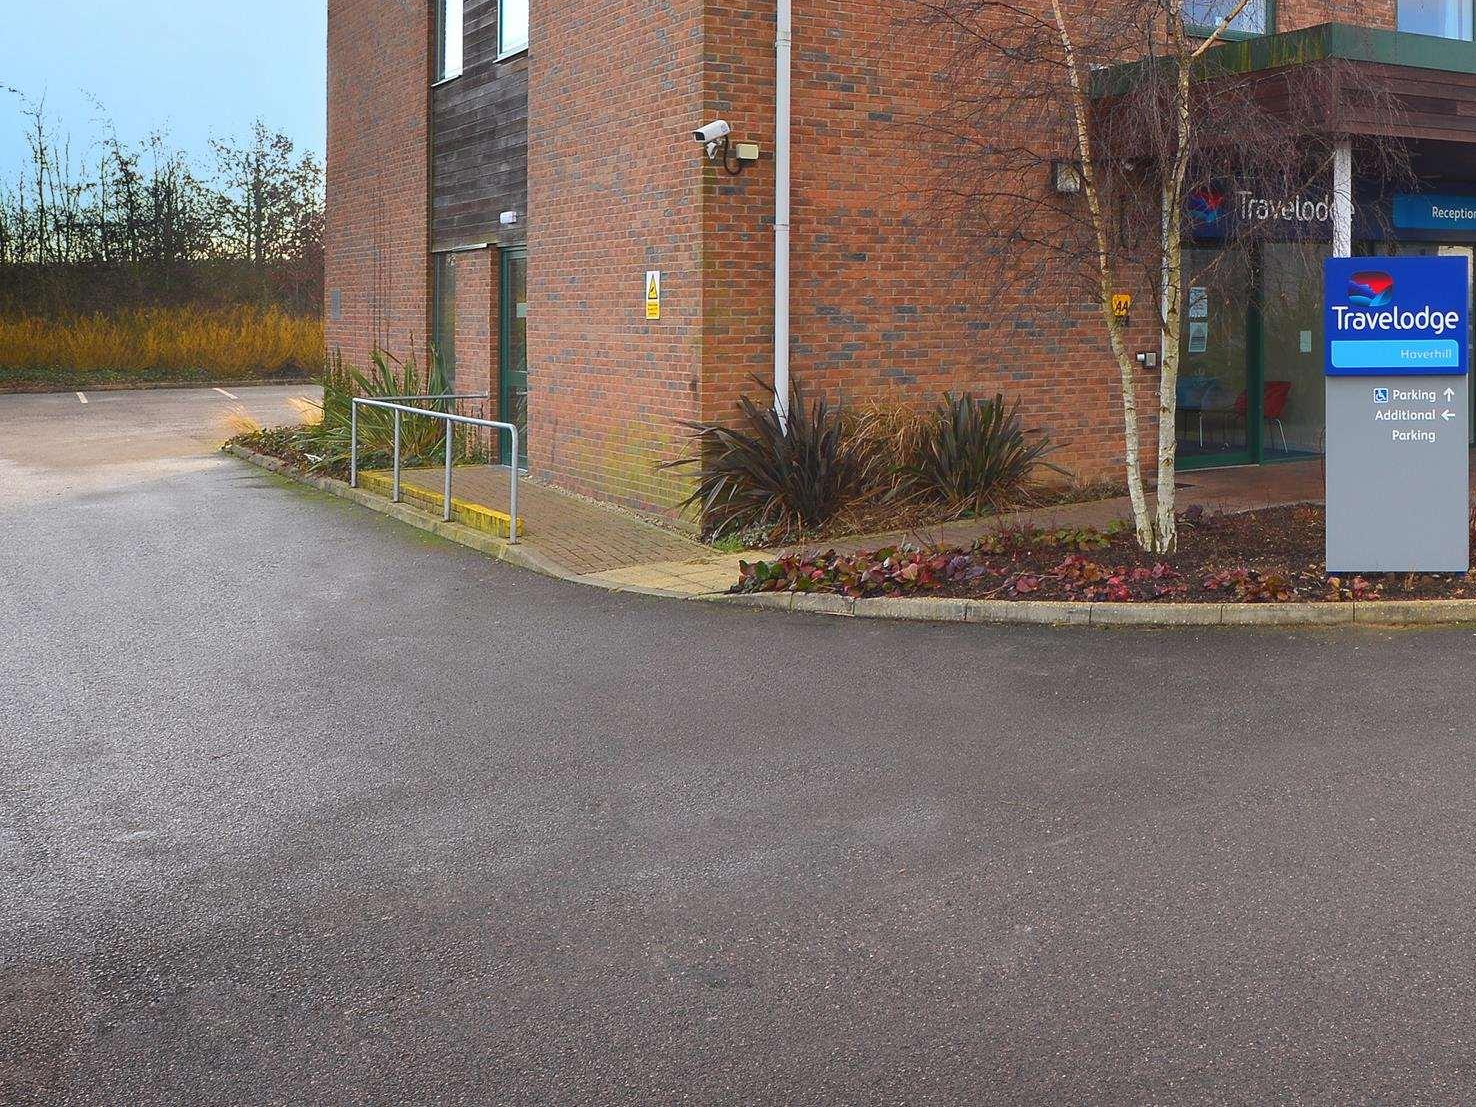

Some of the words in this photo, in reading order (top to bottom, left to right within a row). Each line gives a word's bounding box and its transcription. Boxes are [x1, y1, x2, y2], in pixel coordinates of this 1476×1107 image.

[1331, 305, 1460, 335] Travelodge
[1400, 348, 1453, 360] Haverhill
[1392, 389, 1437, 403] Parking
[1374, 409, 1437, 421] Additional
[1391, 429, 1437, 443] Parking
